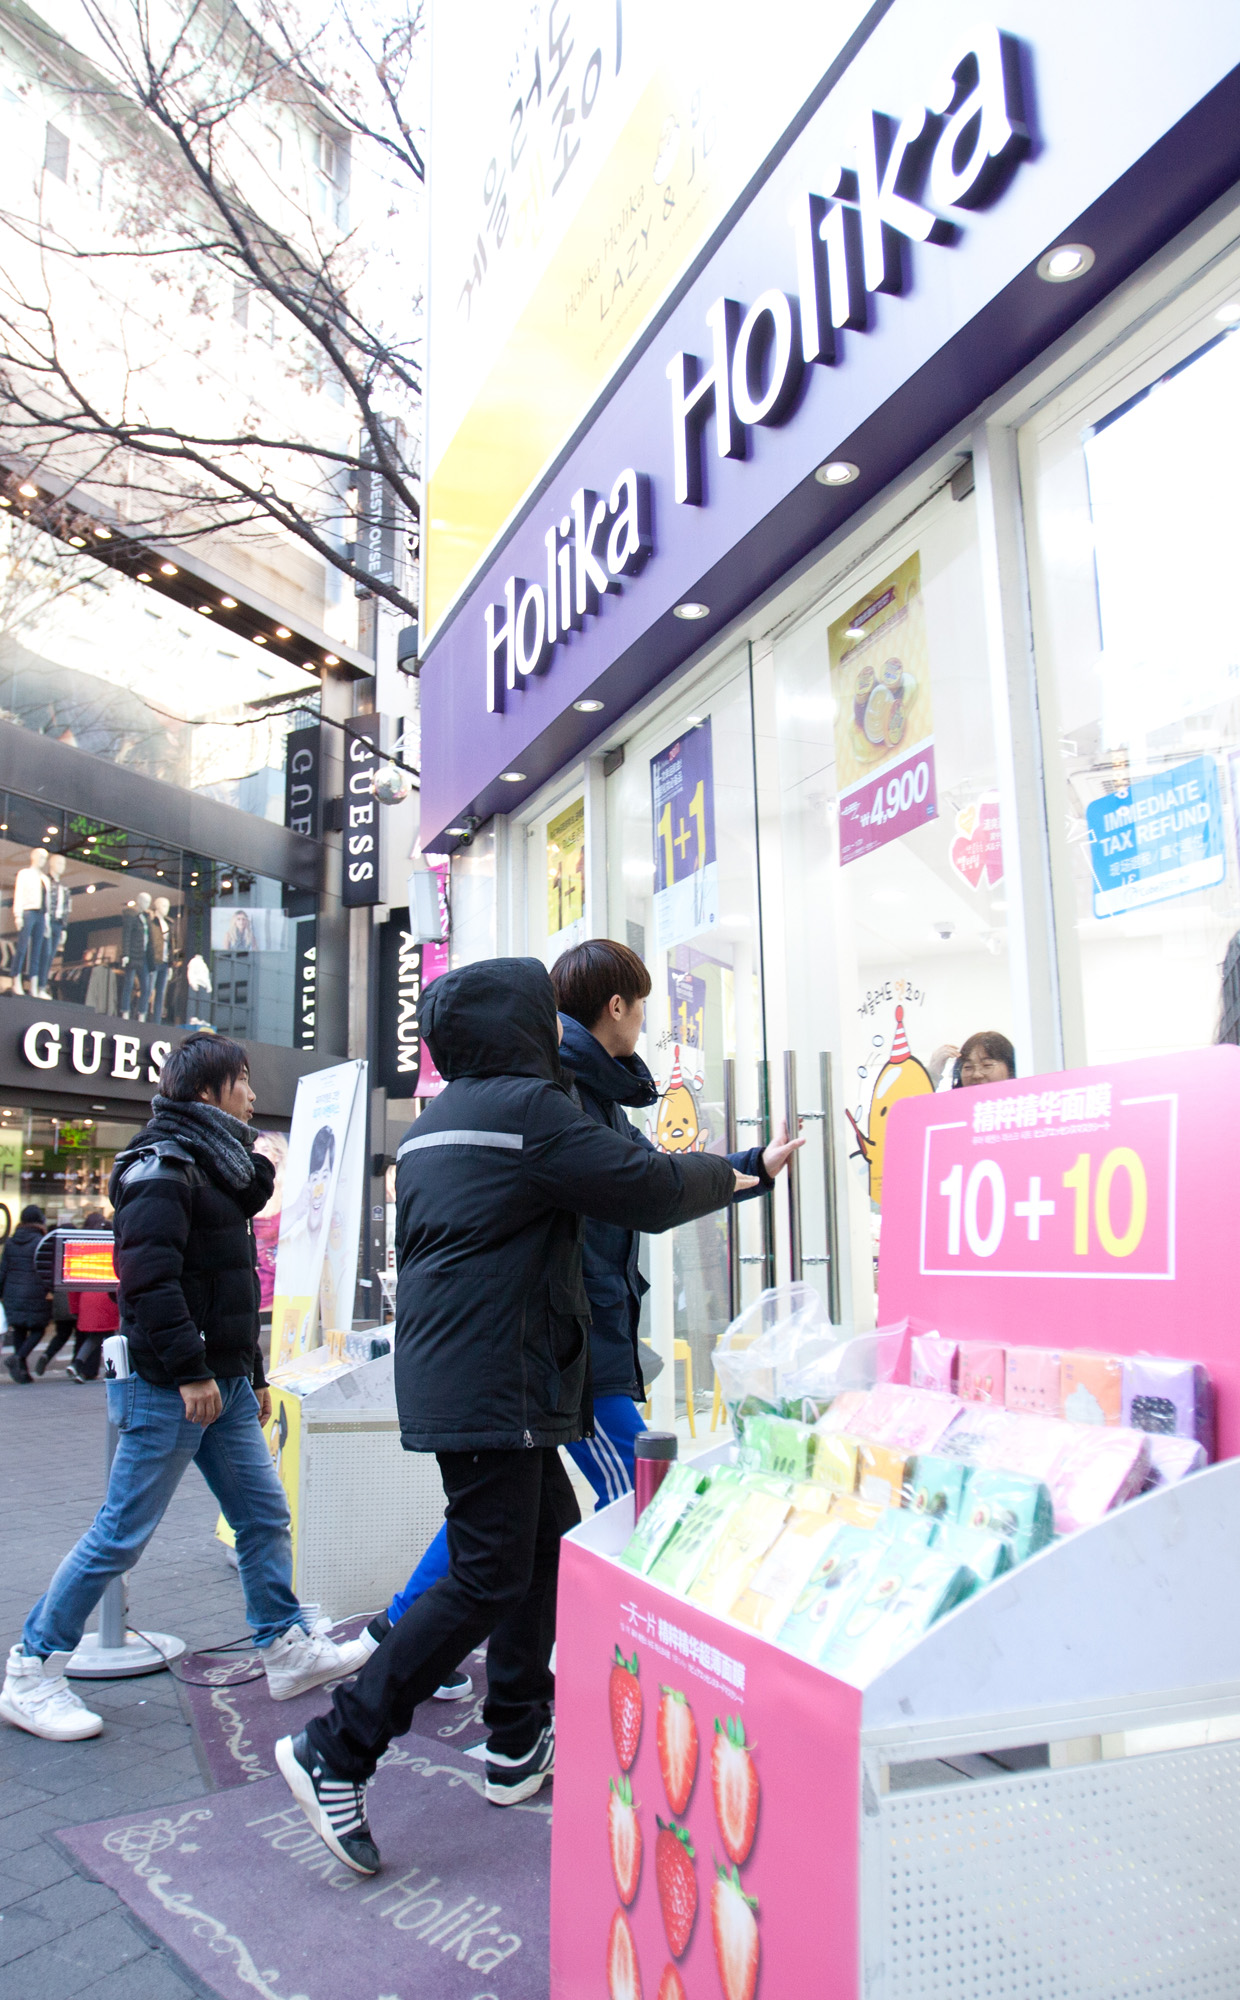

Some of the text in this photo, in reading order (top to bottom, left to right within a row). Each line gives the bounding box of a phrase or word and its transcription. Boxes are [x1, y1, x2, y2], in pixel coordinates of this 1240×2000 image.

[600, 213, 653, 322] LAZY
[484, 22, 1032, 713] Holika Holika
[348, 735, 375, 883] GUESS
[658, 780, 706, 888] 1+1
[1099, 802, 1211, 857] TAX REFUND
[1103, 779, 1200, 832] IMMEDIATE
[397, 930, 421, 1073] ARITAUM
[972, 1082, 1113, 1134] 精粹精华面膜
[939, 1146, 1149, 1258] 10+10
[359, 1867, 523, 1975] Holika
